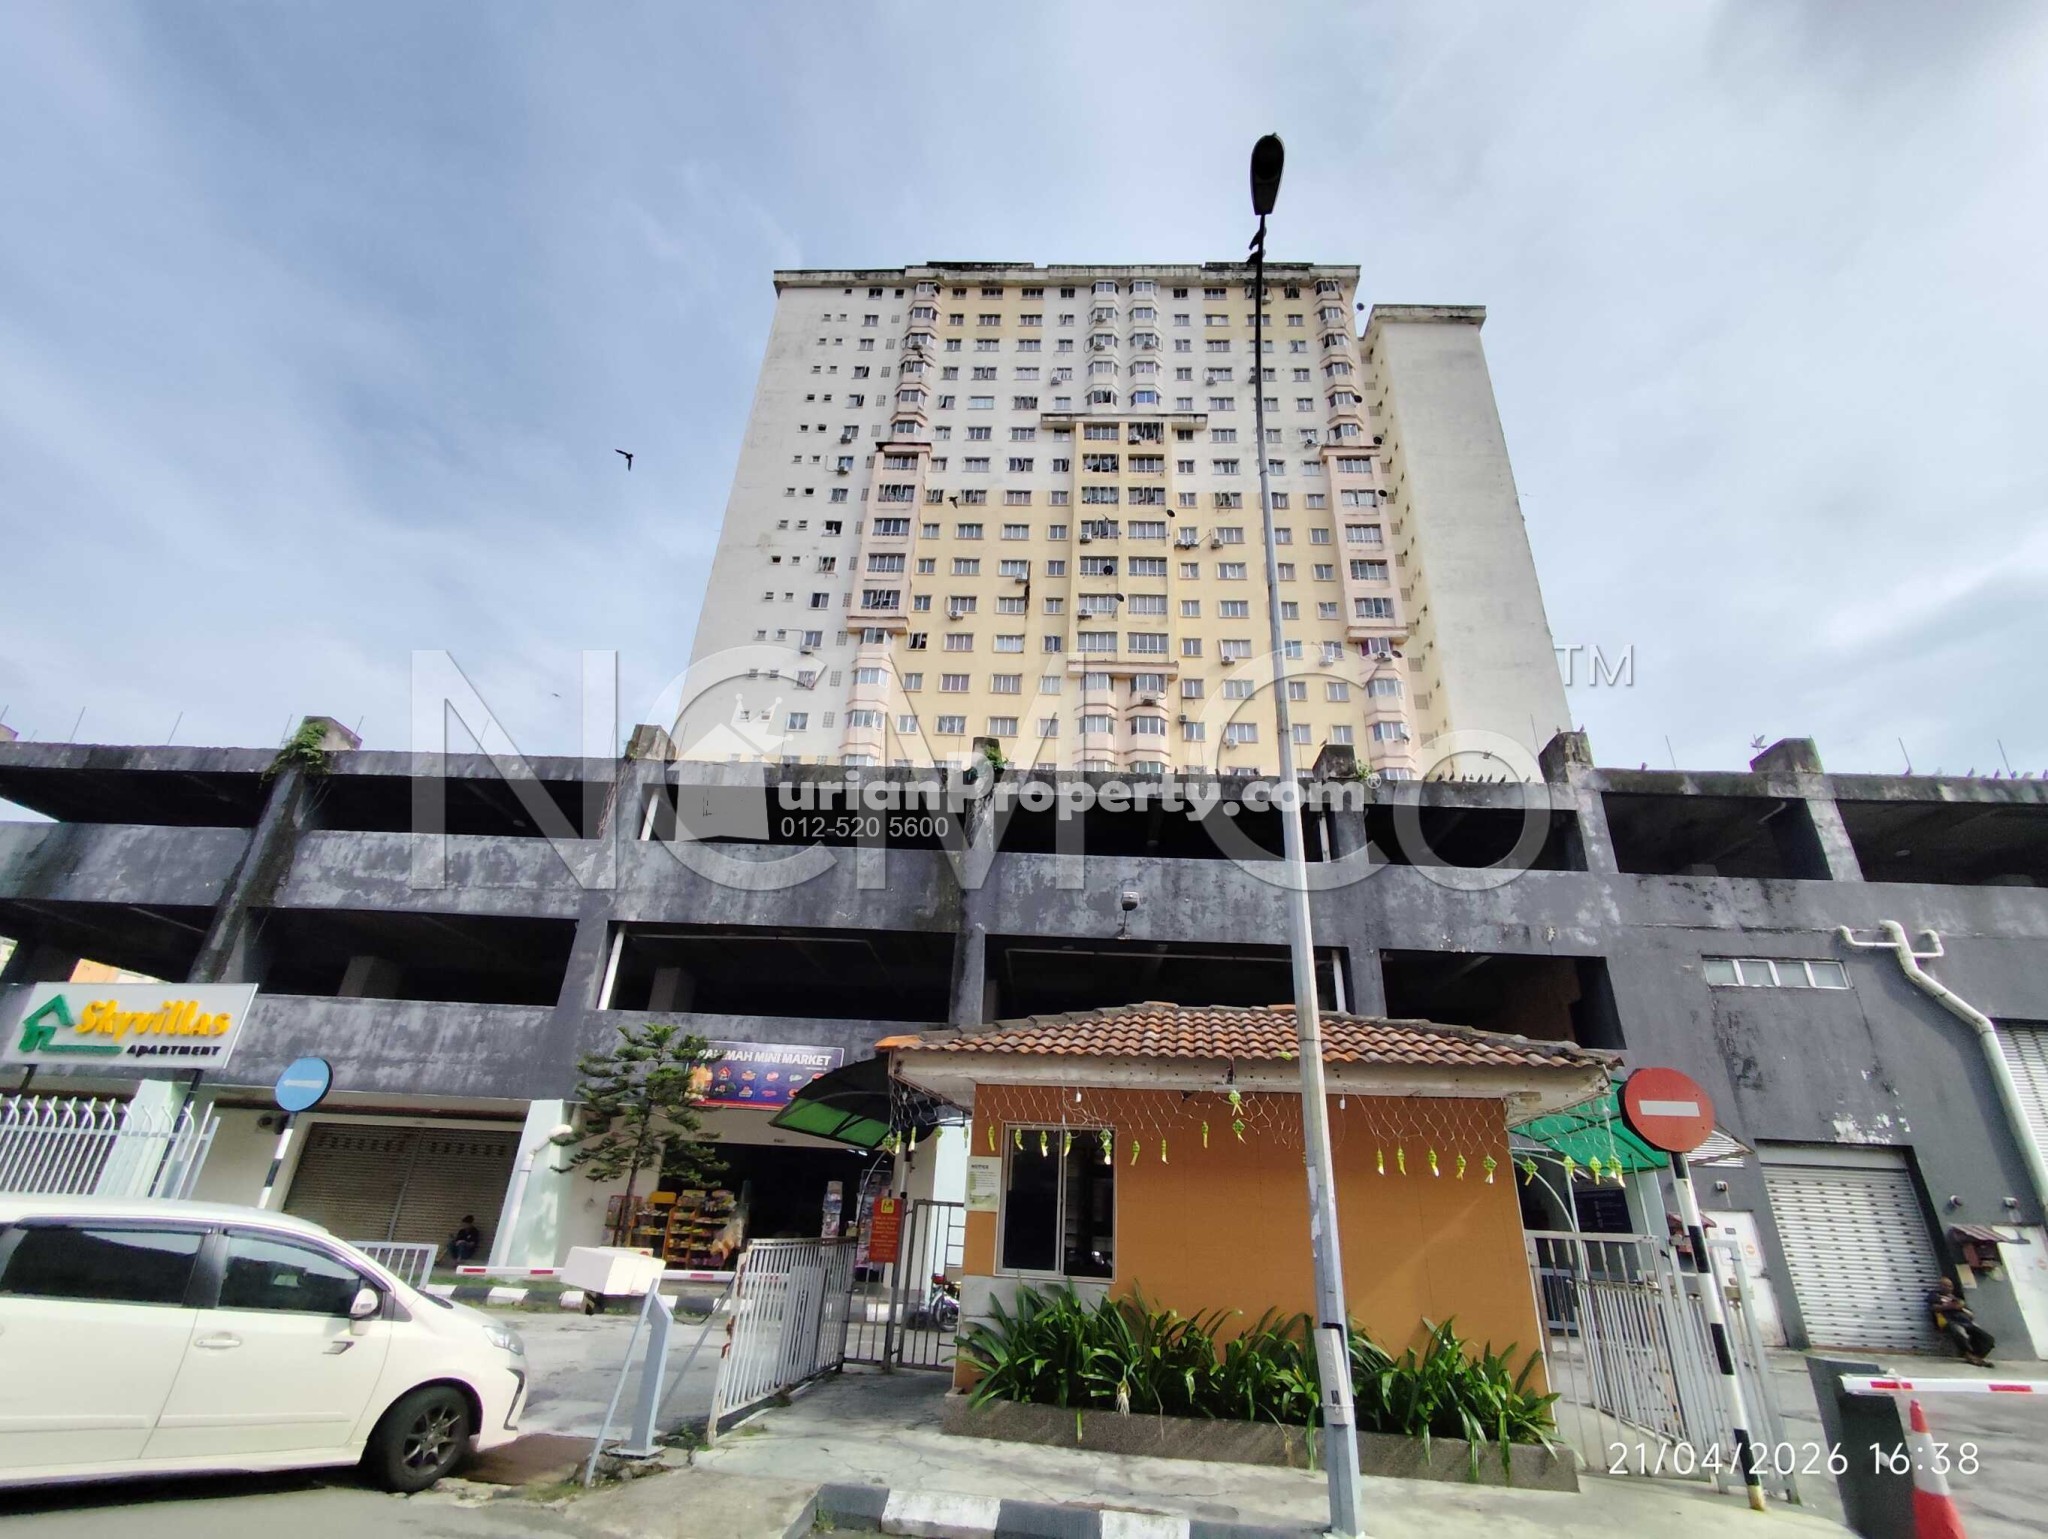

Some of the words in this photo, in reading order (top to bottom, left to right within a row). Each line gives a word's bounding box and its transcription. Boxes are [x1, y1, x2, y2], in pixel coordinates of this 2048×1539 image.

[75, 999, 233, 1043] Skyvillas
[754, 1051, 781, 1063] MINI
[781, 1053, 832, 1066] MARKET
